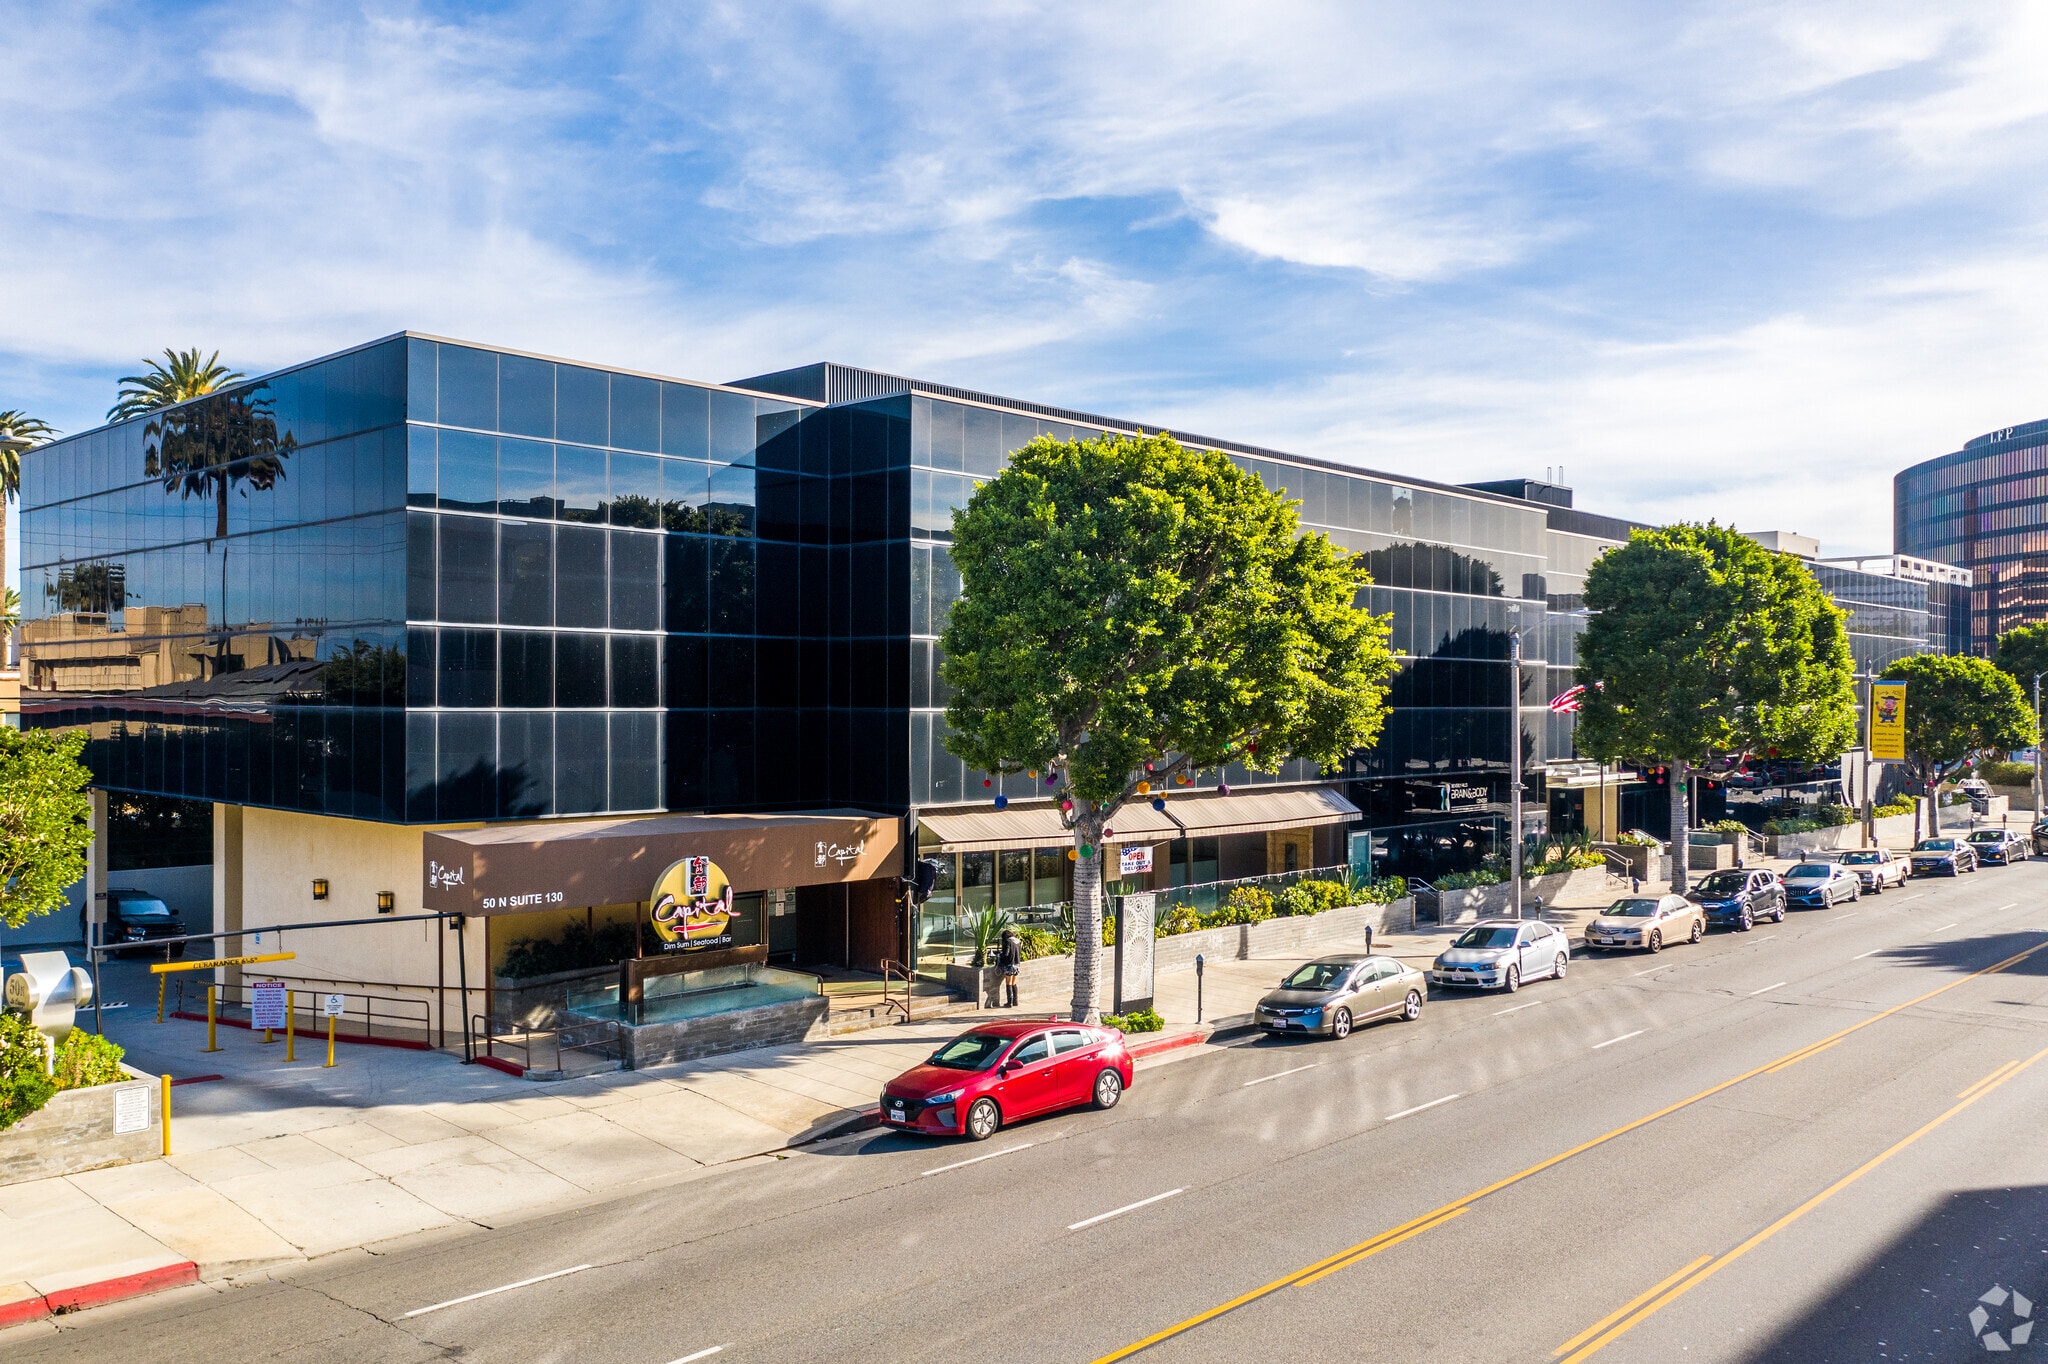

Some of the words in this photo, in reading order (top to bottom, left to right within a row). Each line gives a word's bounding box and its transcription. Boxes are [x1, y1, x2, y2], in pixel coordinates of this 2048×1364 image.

[1990, 428, 2013, 443] LFP
[828, 840, 867, 866] Capital
[1128, 851, 1145, 860] OPEN
[438, 865, 465, 891] Capital
[482, 897, 496, 908] 50
[499, 896, 507, 907] N
[509, 893, 543, 906] SUITE
[545, 891, 563, 903] 130
[656, 885, 741, 940] Capital
[664, 942, 676, 950] Dim
[677, 941, 690, 949] Sum
[693, 937, 719, 947] Seafood
[193, 958, 240, 969] CLEARANCE
